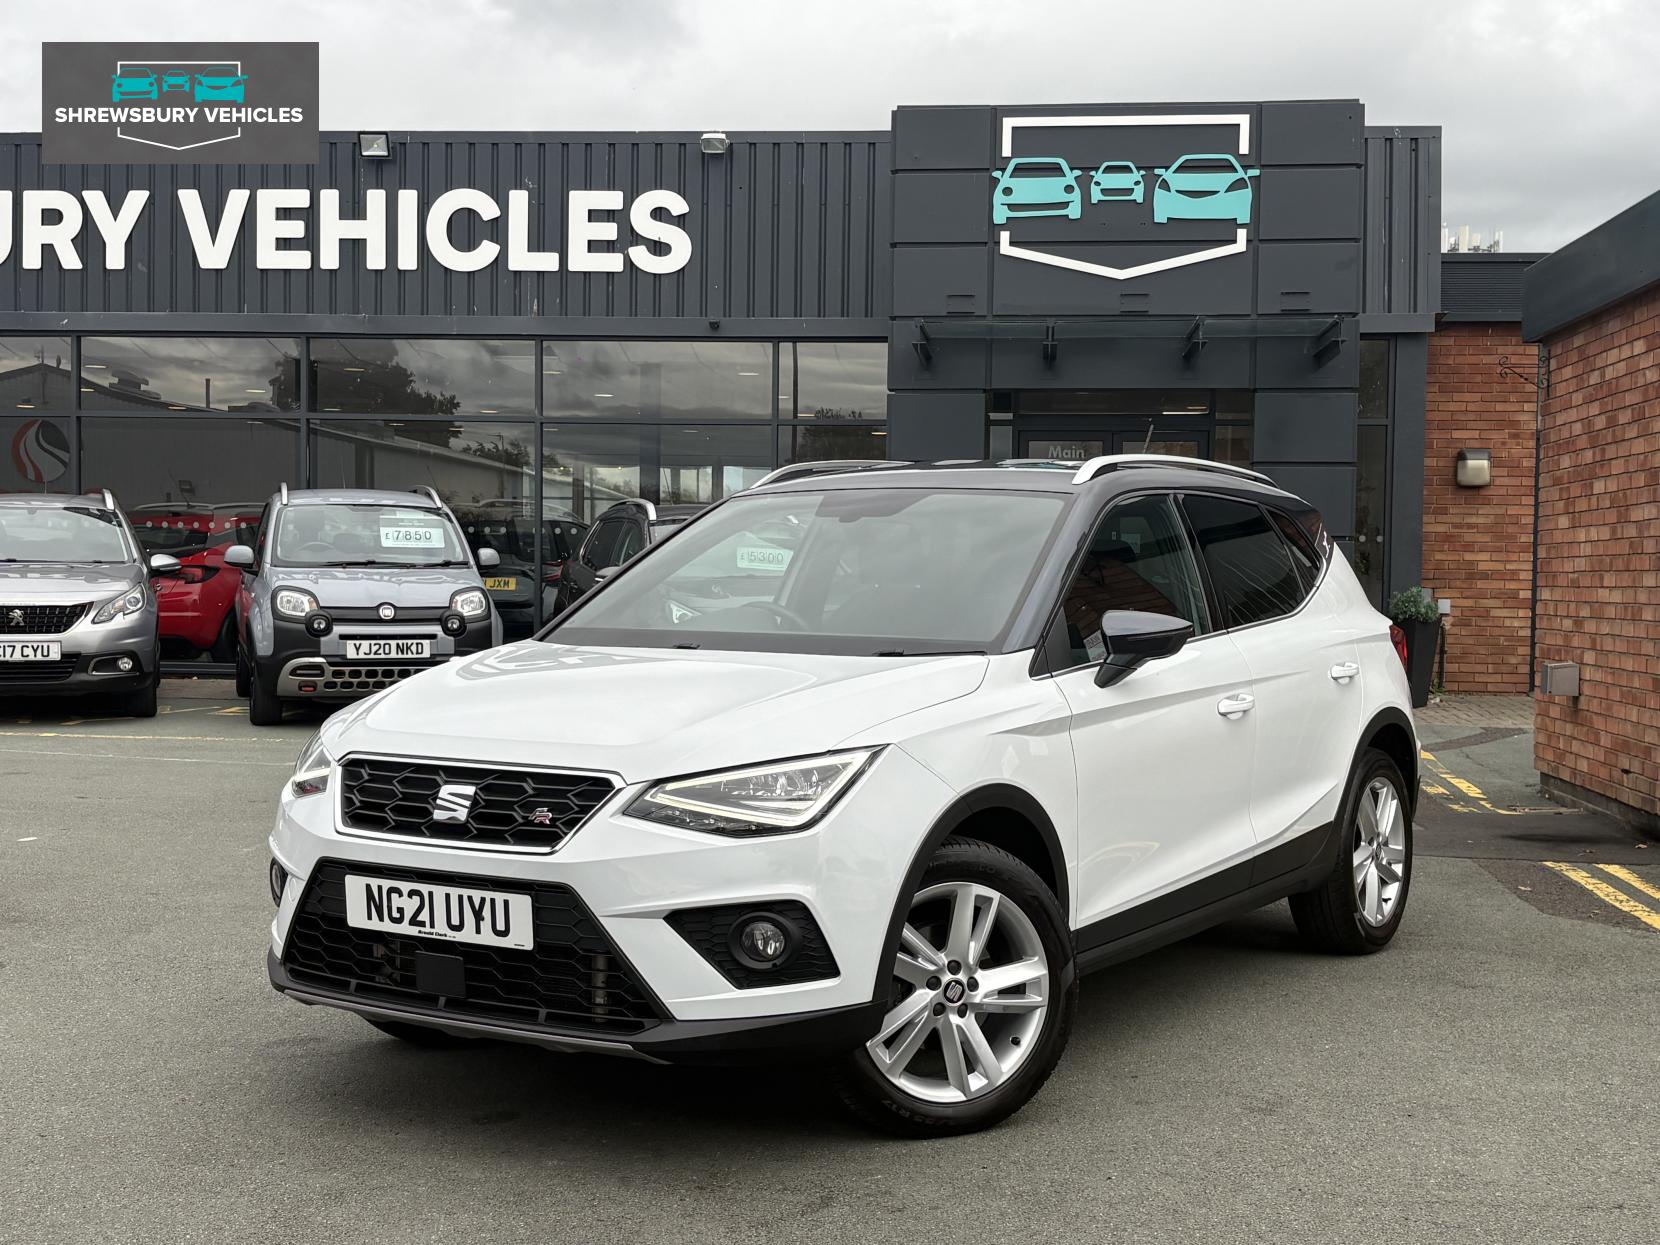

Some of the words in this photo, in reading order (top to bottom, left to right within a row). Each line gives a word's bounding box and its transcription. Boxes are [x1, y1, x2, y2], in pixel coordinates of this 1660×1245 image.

[0, 189, 150, 270] RY
[177, 188, 693, 274] VEHICLES
[1049, 445, 1085, 459] Main
[0, 644, 16, 658] 17
[20, 644, 50, 658] CYU
[353, 642, 392, 656] YJ20
[396, 642, 424, 655] NKD
[365, 883, 436, 929] NG21
[444, 892, 511, 938] UYU
